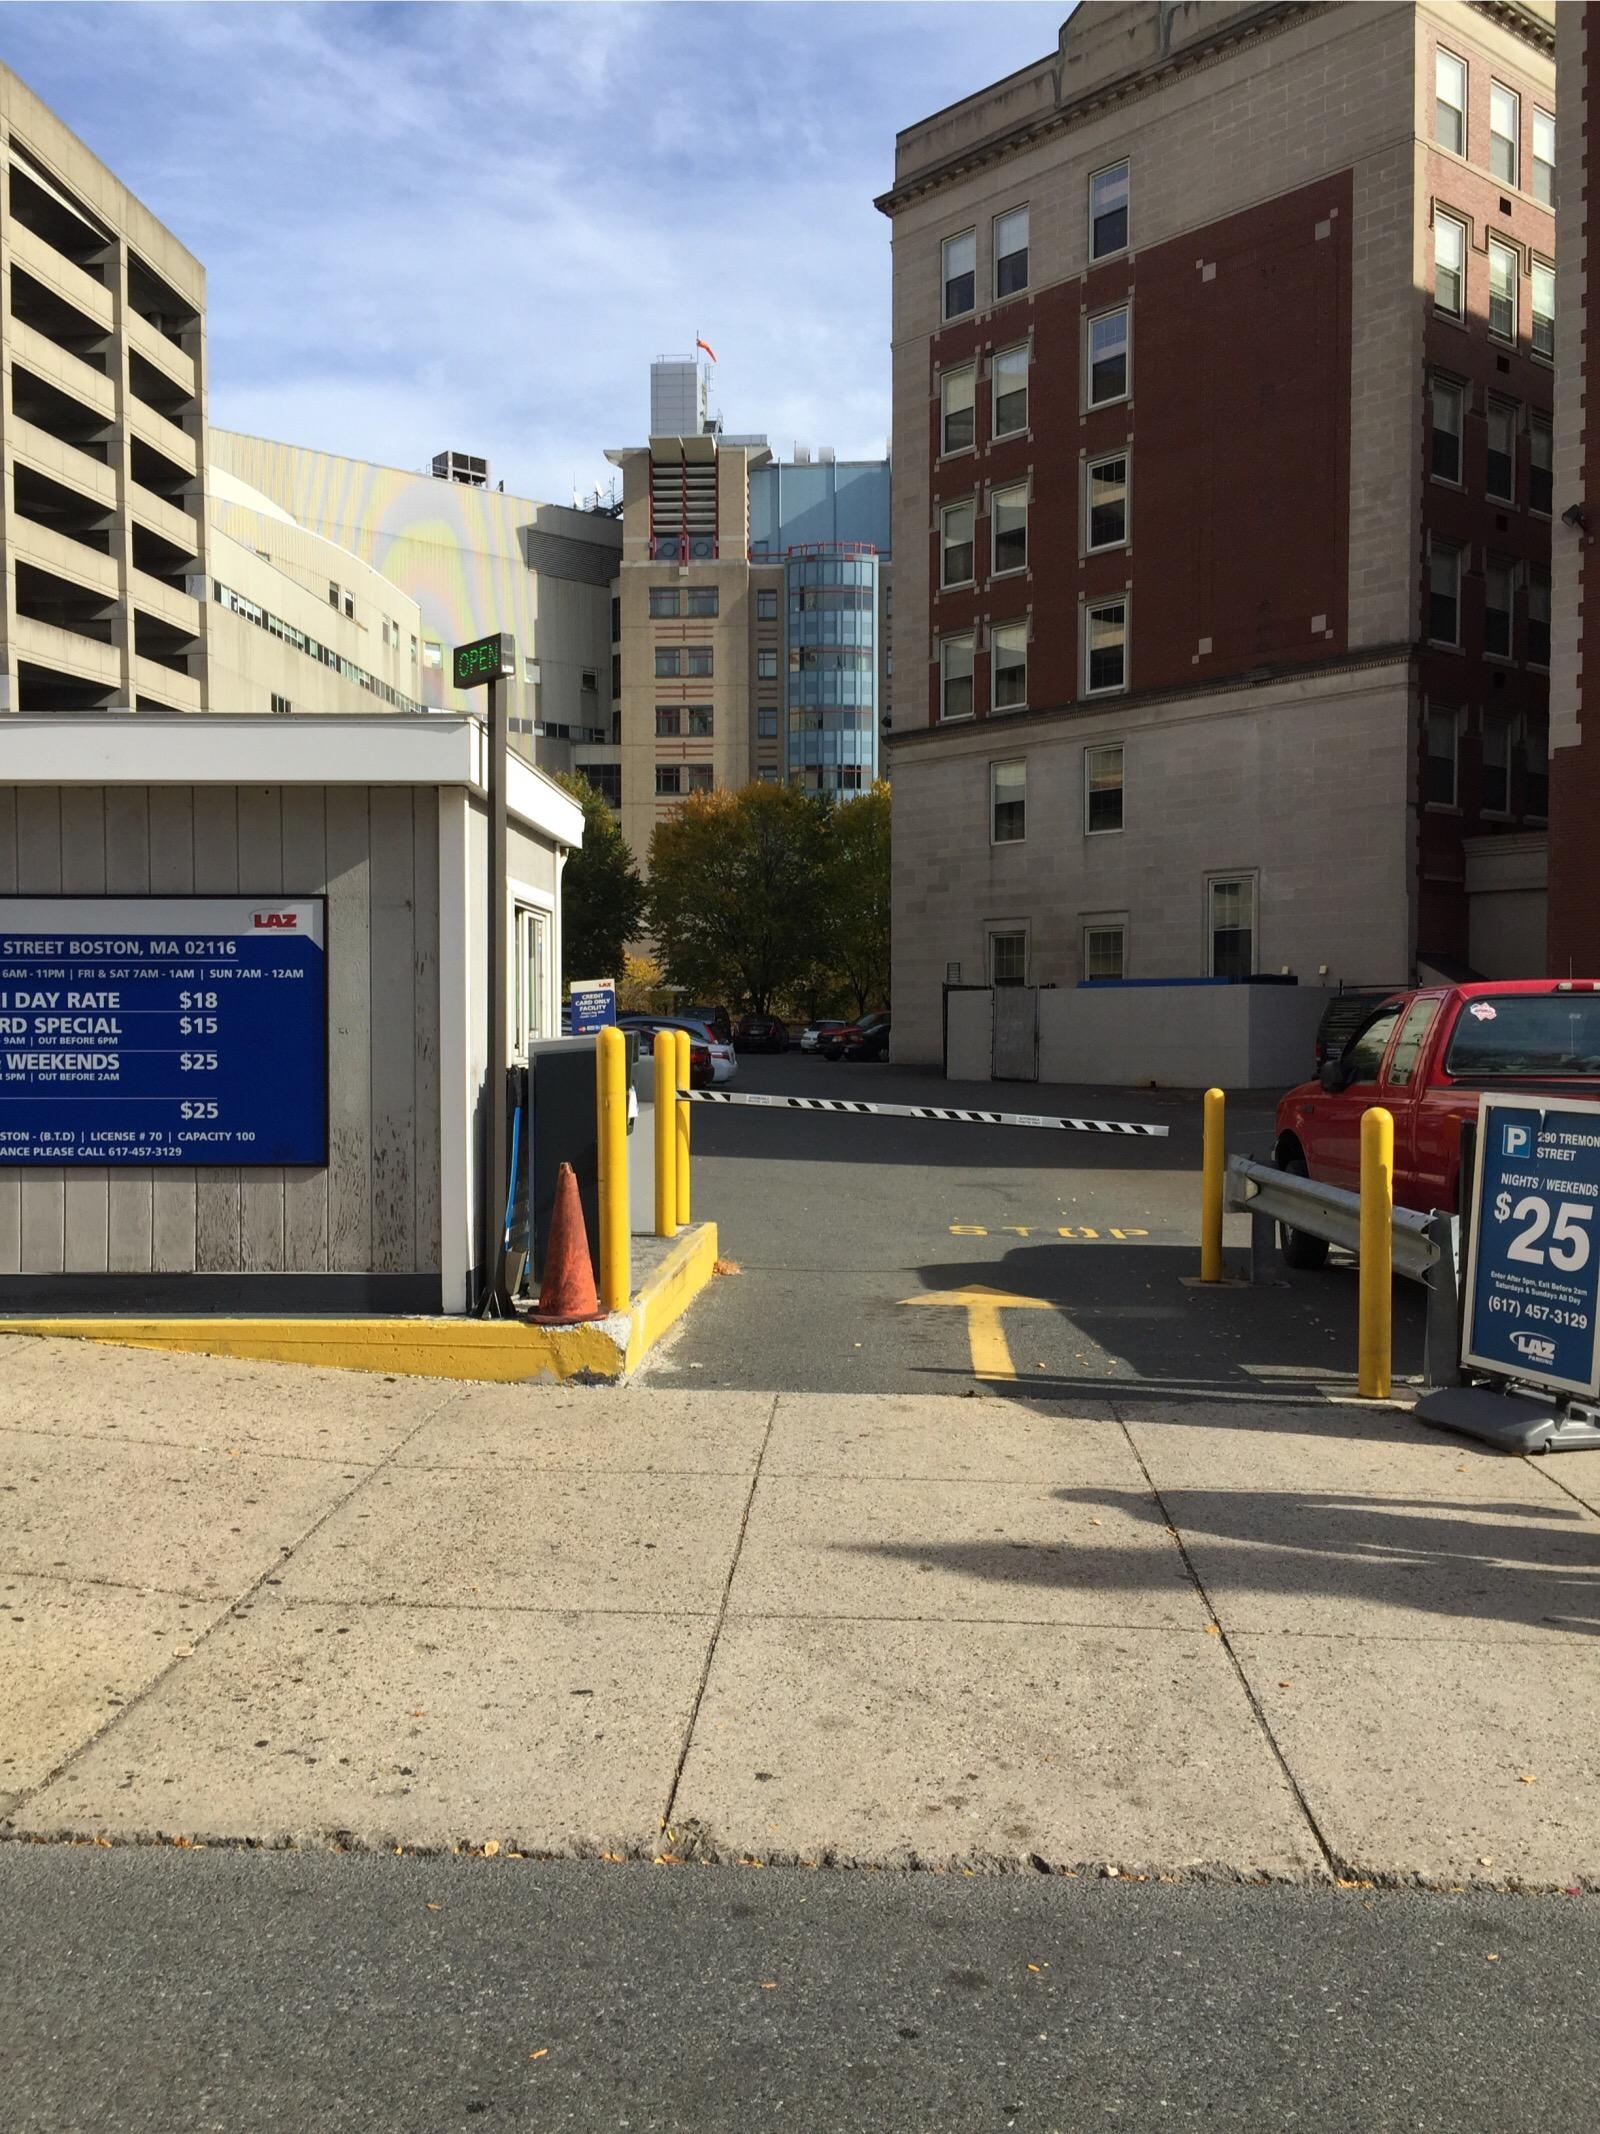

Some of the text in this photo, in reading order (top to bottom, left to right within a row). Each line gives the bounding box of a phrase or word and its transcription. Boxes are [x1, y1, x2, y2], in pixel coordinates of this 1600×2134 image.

[459, 642, 498, 677] OPEN
[254, 914, 297, 928] LAZ
[3, 941, 237, 957] STREET BOSTON, MA 02116
[2, 969, 28, 979] 6AM
[36, 969, 65, 979] 11PM
[78, 969, 95, 979] FRI
[109, 969, 131, 979] SAT
[133, 969, 159, 979] 7AM
[169, 969, 195, 979] 1AM
[209, 969, 233, 979] SUN
[236, 969, 262, 979] 7AM
[272, 969, 304, 979] 12AM
[15, 992, 61, 1009] DAY
[67, 992, 121, 1009] RATE
[179, 990, 218, 1010] $18
[579, 1004, 607, 1012] FACILITY
[35, 1017, 123, 1034] SPECIAL
[180, 1015, 218, 1035] $15
[3, 1036, 26, 1045] 9AM
[38, 1036, 57, 1045] OUT
[59, 1036, 95, 1045] BEFORE
[98, 1036, 118, 1045] 6PM
[6, 1053, 120, 1070] WEEKENDS
[180, 1052, 219, 1072] $25
[5, 1072, 26, 1081] 5PM
[38, 1072, 57, 1081] OUT
[59, 1072, 95, 1081] BEFORE
[98, 1072, 120, 1081] 2AM
[180, 1100, 219, 1120] $25
[40, 1131, 76, 1143] (B.T.D)
[90, 1131, 136, 1142] LICENSE
[148, 1132, 163, 1142] 70
[177, 1131, 233, 1142] CAPACITY
[235, 1131, 256, 1142] 100
[1537, 1131, 1557, 1144] 290
[34, 1147, 75, 1156] PLEASE
[77, 1147, 106, 1156] CALL
[108, 1147, 182, 1157] 617-457-3129
[1536, 1147, 1577, 1161] STREET
[1501, 1173, 1540, 1189] NIGHTS
[1546, 1178, 1599, 1197] WEEKENDS
[948, 1225, 1149, 1240] STOP
[1494, 1191, 1594, 1272] $25
[1495, 1281, 1525, 1294] Saturdays
[1531, 1288, 1558, 1300] Sundays
[1568, 1296, 1582, 1306] Day
[1507, 1274, 1521, 1283] After
[1551, 1282, 1573, 1294] Before
[1573, 1287, 1588, 1297] 2am
[1488, 1295, 1588, 1330] (617) 457-3129
[1517, 1336, 1556, 1360] LAZ
